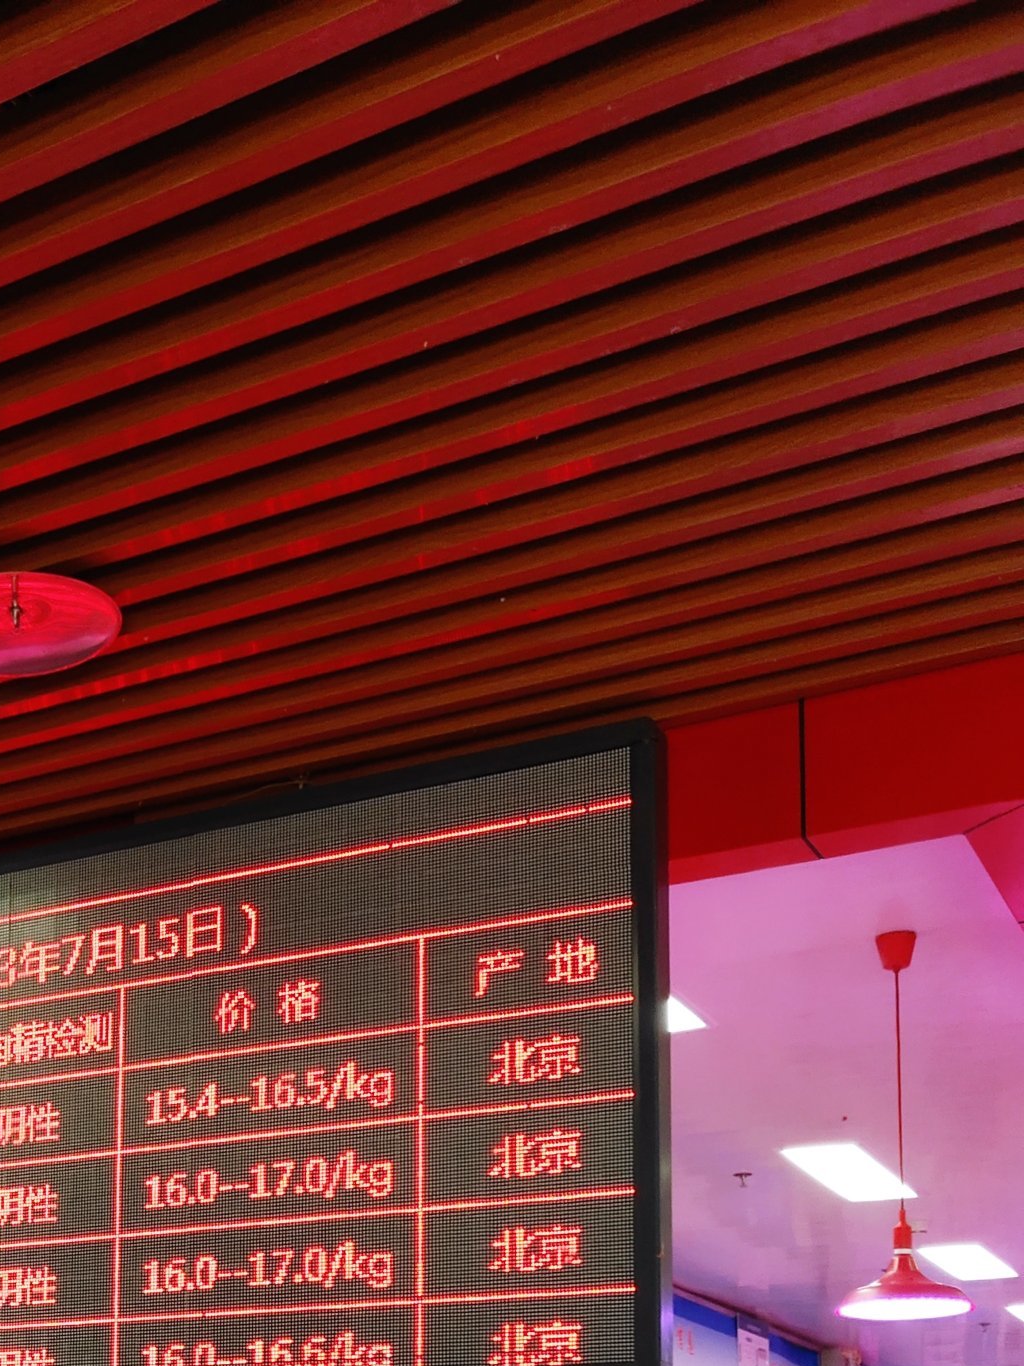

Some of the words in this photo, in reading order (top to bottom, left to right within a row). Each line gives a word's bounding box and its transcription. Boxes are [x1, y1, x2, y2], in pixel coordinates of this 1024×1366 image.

[487, 1034, 582, 1085] 北京
[487, 1128, 582, 1178] 北京
[488, 1226, 582, 1273] 北京
